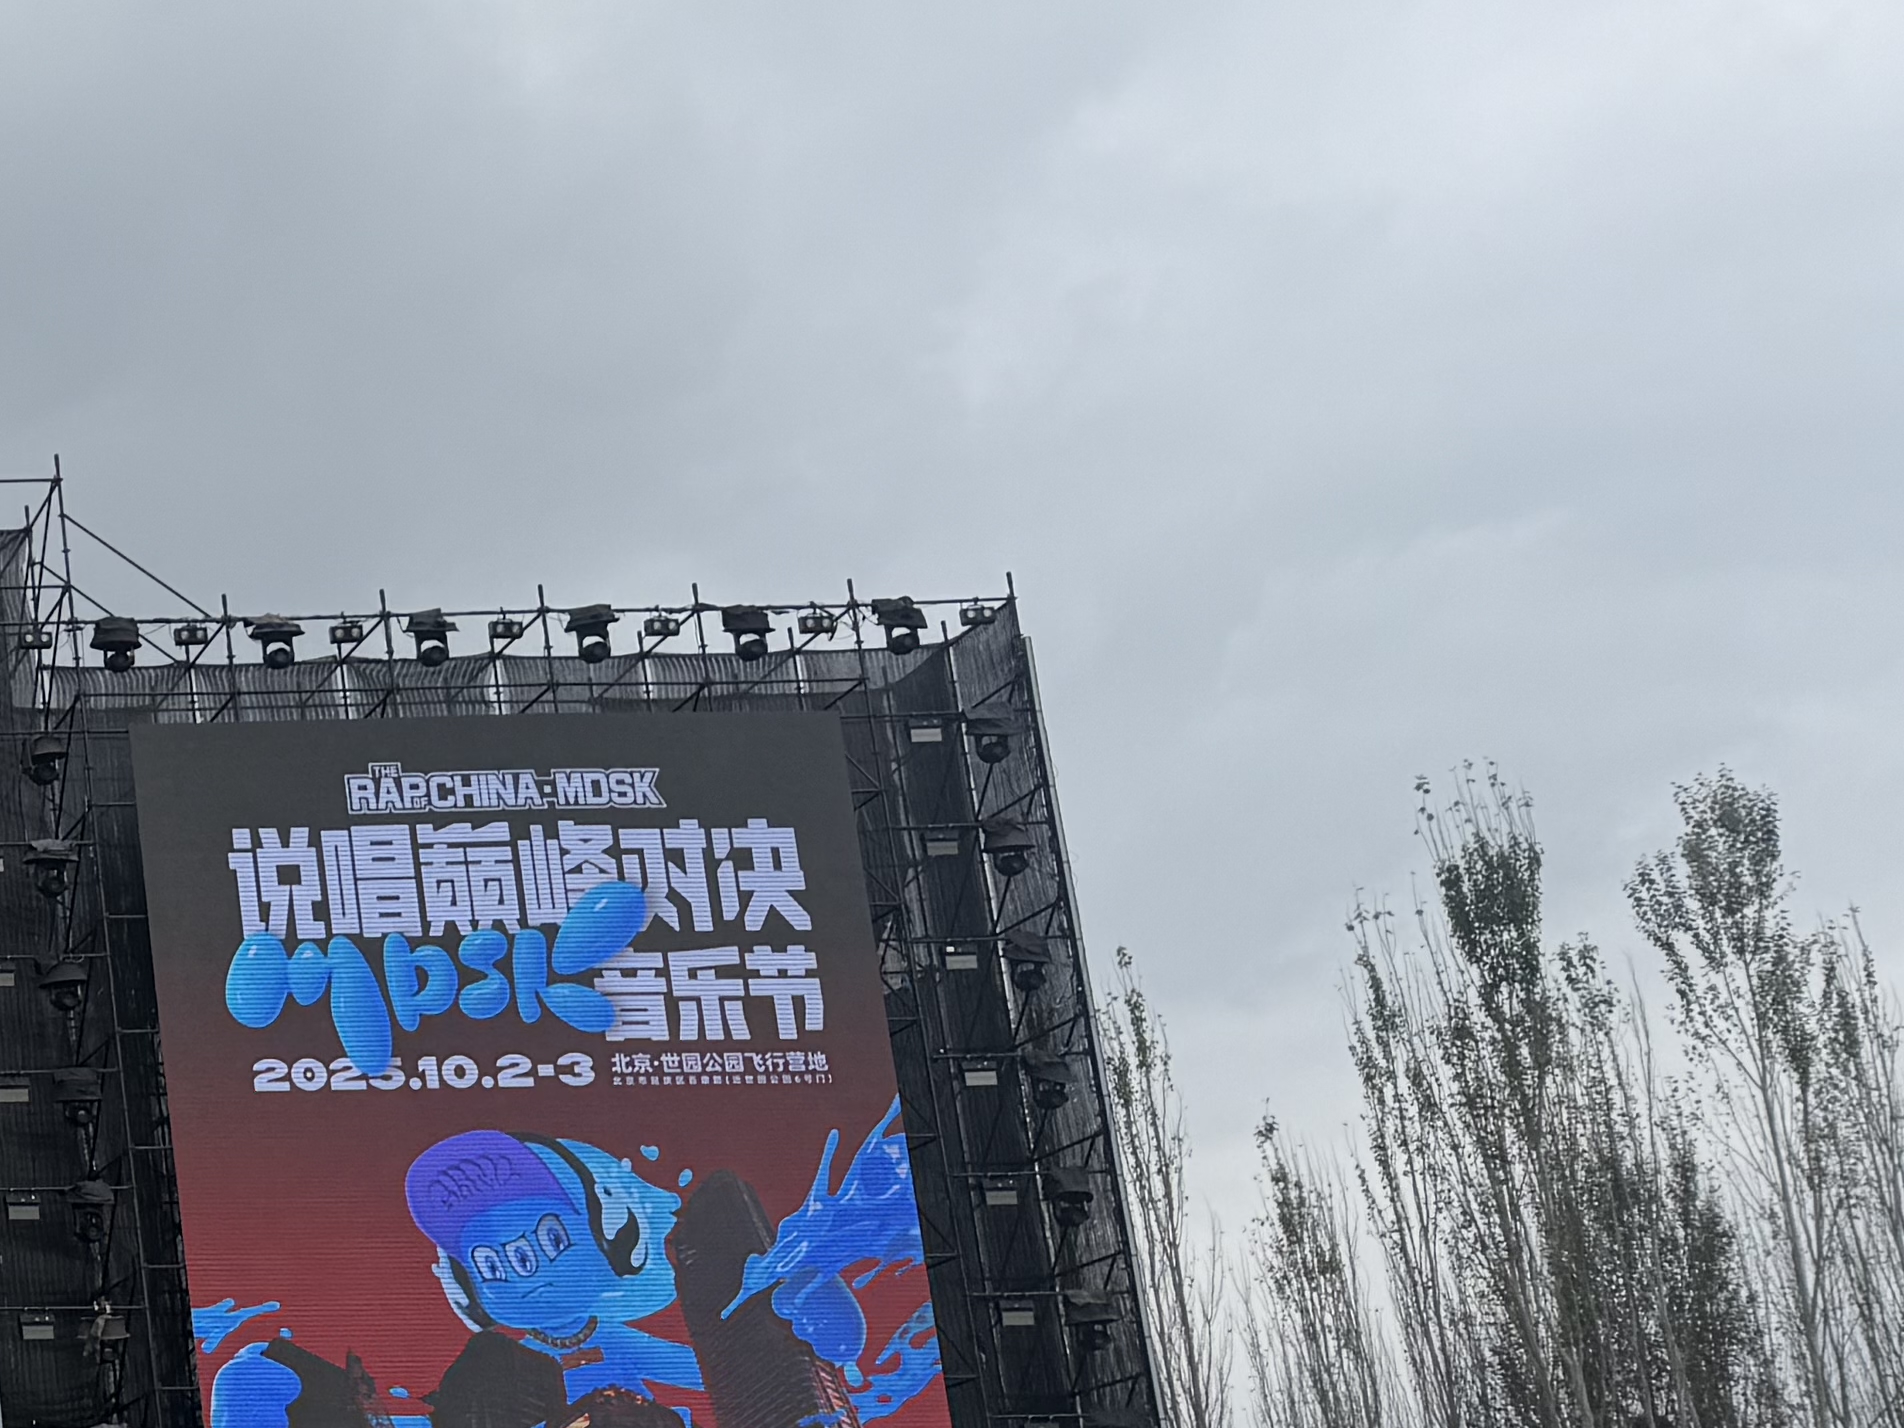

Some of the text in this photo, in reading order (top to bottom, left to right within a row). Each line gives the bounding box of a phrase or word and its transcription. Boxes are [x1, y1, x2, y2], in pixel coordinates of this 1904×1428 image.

[228, 818, 812, 940] 说唱巅峰对决
[593, 945, 824, 1041] 音乐节
